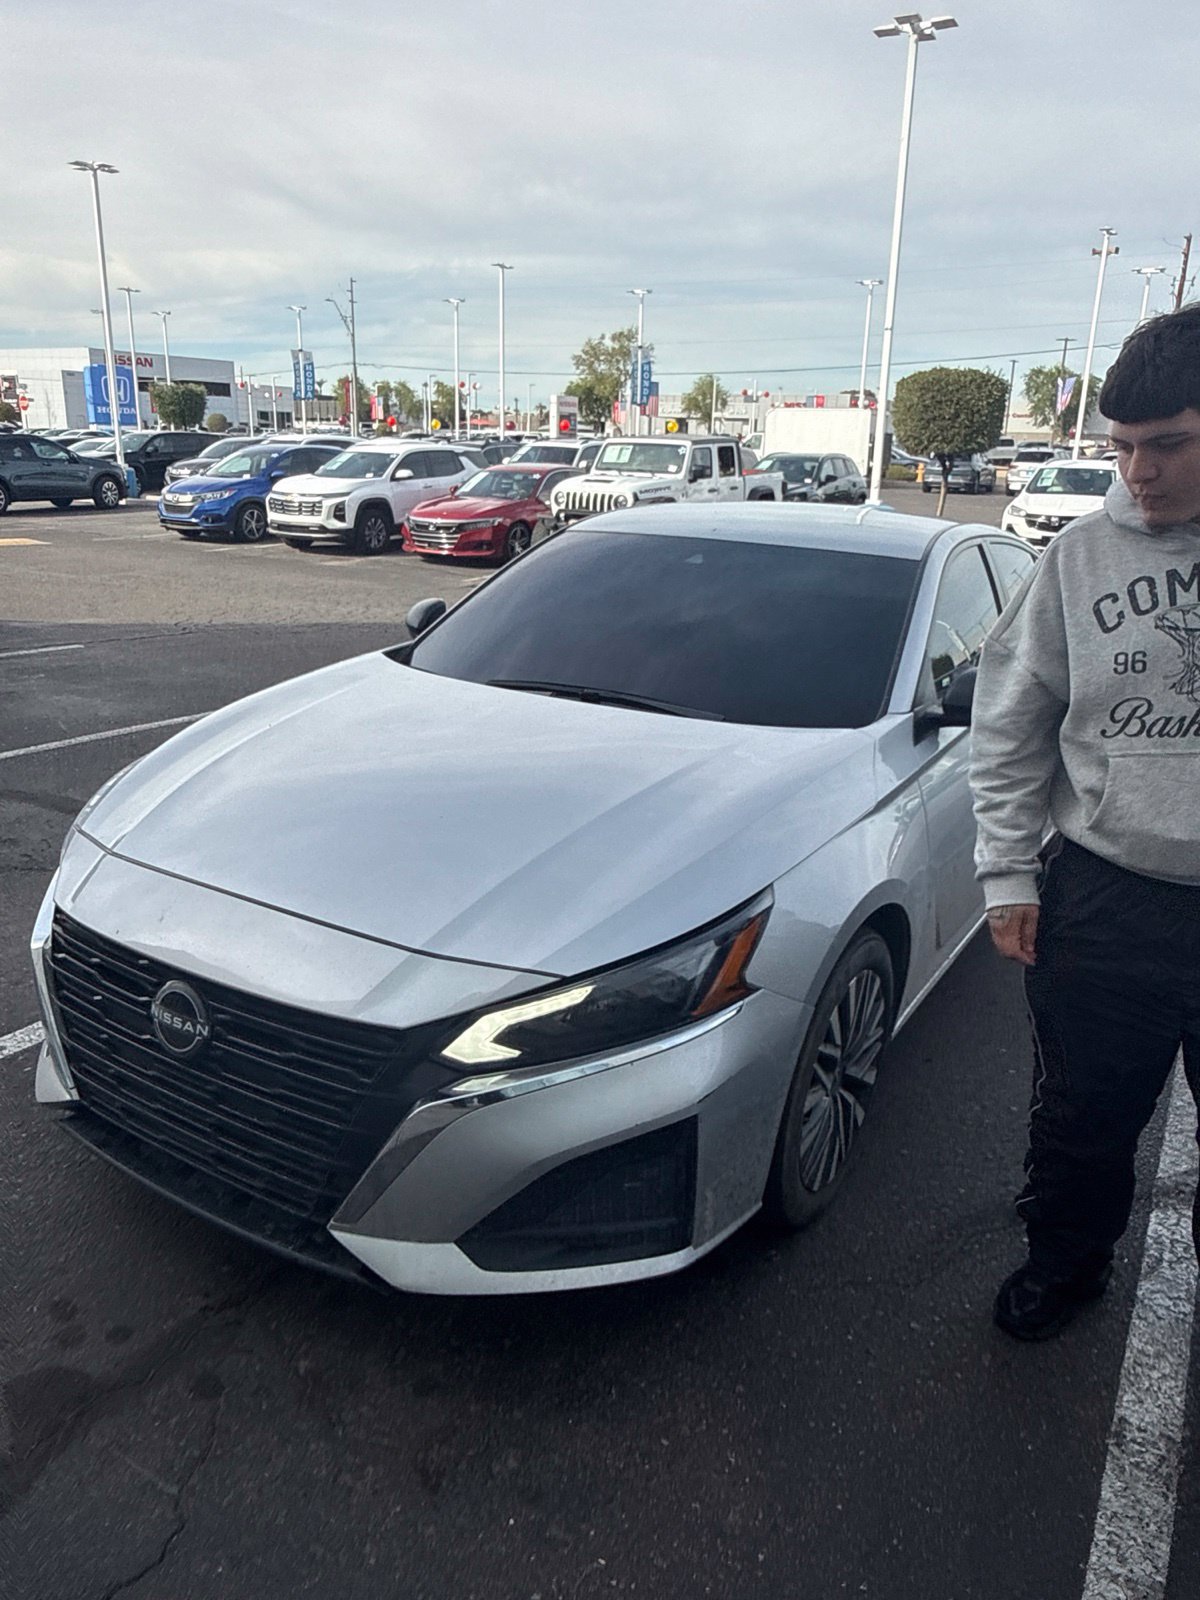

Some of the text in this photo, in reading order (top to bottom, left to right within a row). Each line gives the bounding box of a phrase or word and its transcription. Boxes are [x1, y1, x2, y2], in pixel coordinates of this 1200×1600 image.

[104, 353, 153, 368] ISSAN
[305, 364, 314, 398] HONDA
[1092, 562, 1200, 634] COM
[1112, 650, 1148, 675] 96
[151, 1003, 209, 1036] NISSAN
